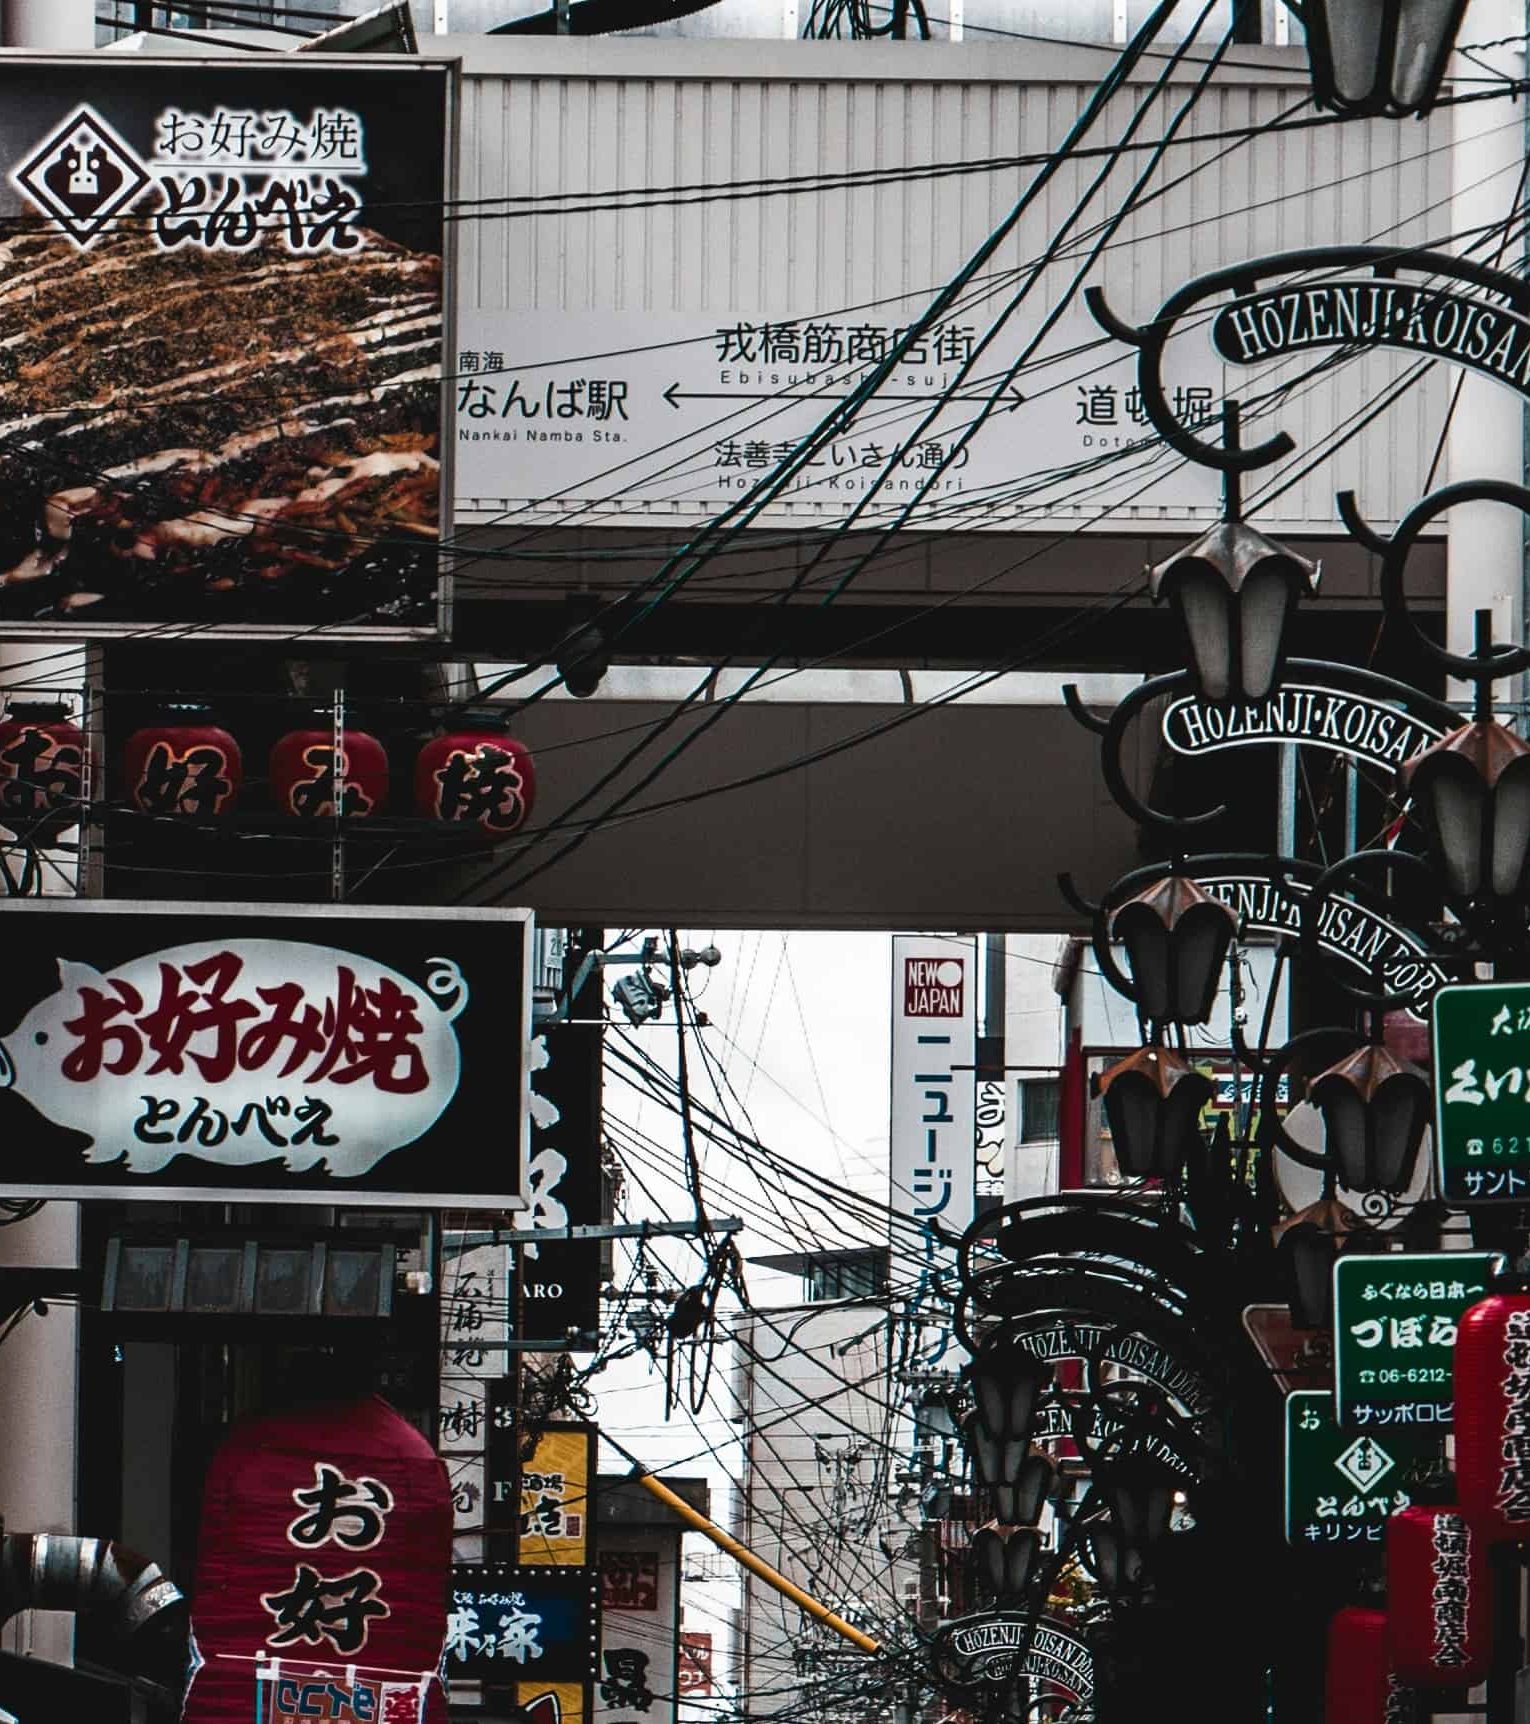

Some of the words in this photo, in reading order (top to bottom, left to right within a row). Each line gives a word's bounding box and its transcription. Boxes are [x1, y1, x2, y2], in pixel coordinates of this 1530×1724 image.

[159, 111, 359, 160] お好み焼
[459, 352, 504, 371] 南海
[714, 322, 974, 366] 戎橋筋商店街
[721, 370, 958, 389] Ebisubash-suj
[458, 379, 629, 420] なんば駅
[459, 430, 518, 442] Nankai
[527, 430, 584, 442] Namba
[593, 430, 628, 442] Sta.
[908, 963, 938, 987] NEW
[908, 988, 960, 1015] JAPAN
[60, 949, 431, 1094] お好み焼
[132, 1095, 341, 1148] とんべえ
[1349, 1314, 1459, 1350] づぼら
